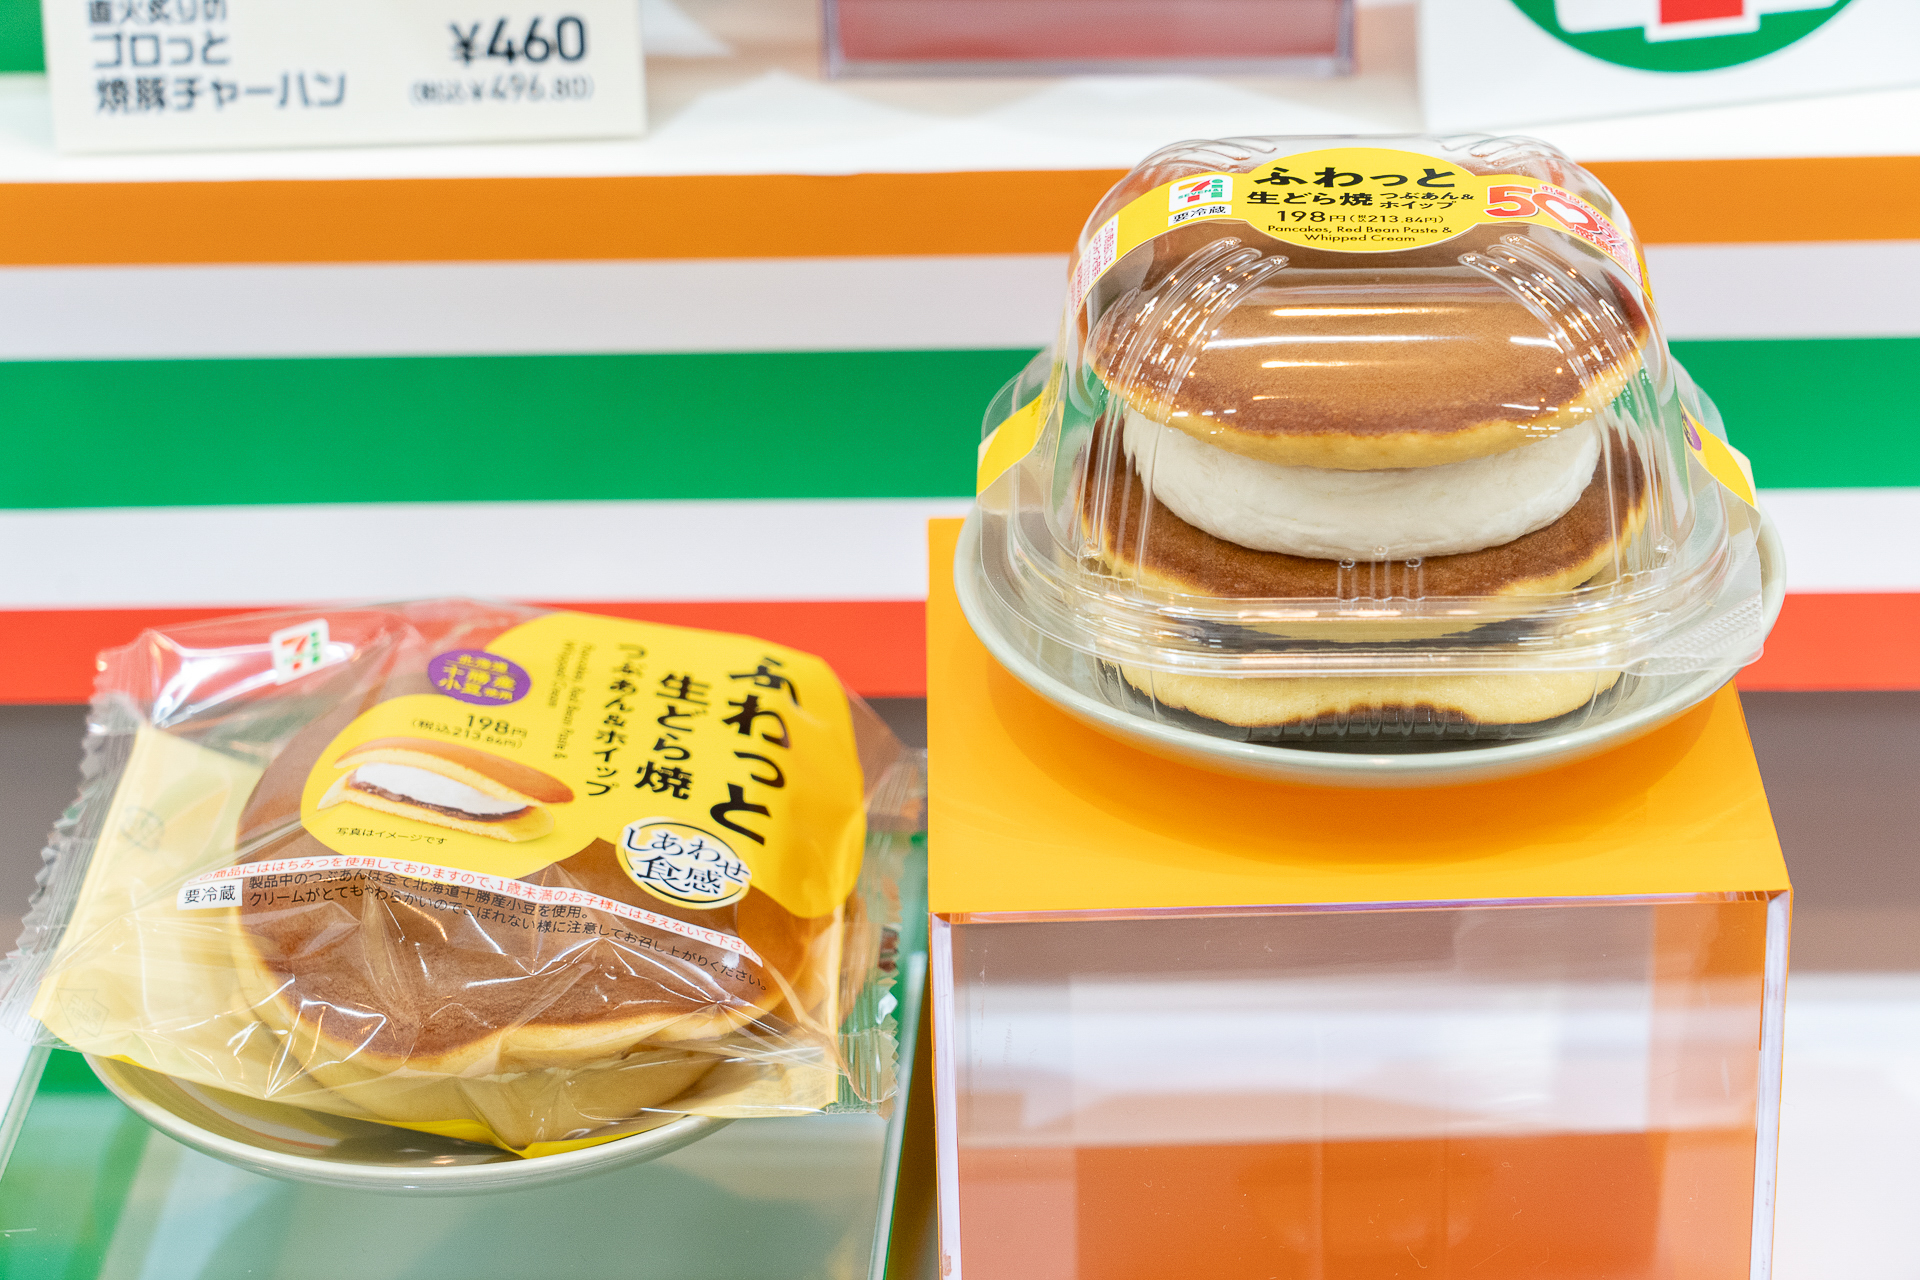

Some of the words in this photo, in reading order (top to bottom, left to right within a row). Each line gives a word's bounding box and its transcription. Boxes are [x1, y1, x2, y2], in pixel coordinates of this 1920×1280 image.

[450, 16, 587, 67] ¥460
[97, 72, 347, 113] 焼豚チャーハン
[1253, 167, 1456, 188] ふわっと
[1246, 191, 1373, 206] 生どら焼
[1379, 200, 1457, 210] ホイップ
[1173, 205, 1227, 224] 要冷蔵
[1267, 224, 1332, 235] Pancakes,
[1337, 225, 1362, 233] Red
[1366, 225, 1400, 234] Bean
[1404, 226, 1439, 234] Paste
[1442, 226, 1453, 234] &
[1304, 234, 1367, 243] Whipped
[1371, 234, 1416, 242] Cream
[467, 713, 528, 738] 198円
[634, 673, 712, 800] 生どら焼
[709, 656, 802, 846] ふわっと
[336, 827, 448, 845] 写真はイメージです
[627, 826, 750, 884] しあわせ
[636, 855, 722, 895] 食感
[184, 885, 236, 905] 要冷蔵
